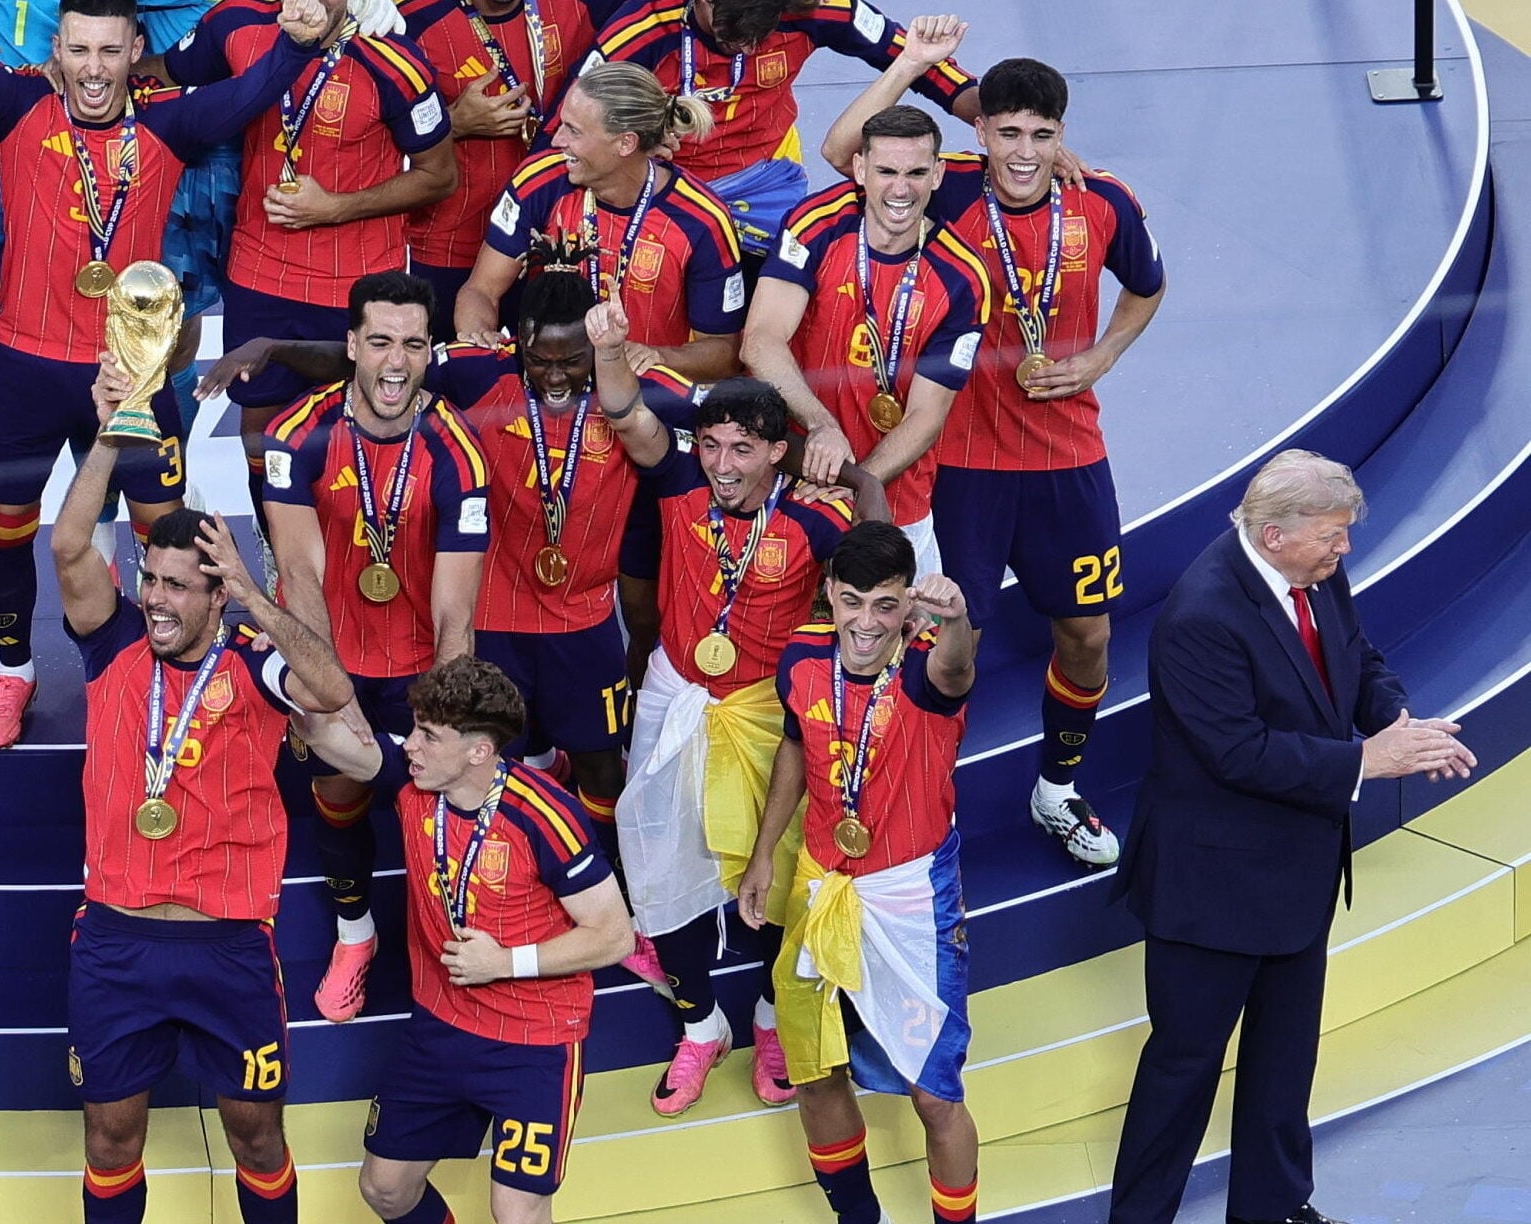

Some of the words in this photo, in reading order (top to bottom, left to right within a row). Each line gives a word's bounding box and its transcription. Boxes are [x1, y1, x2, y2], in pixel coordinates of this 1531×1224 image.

[294, 109, 307, 132] WORLD
[303, 95, 312, 110] CUP
[309, 72, 326, 97] 2026
[105, 222, 115, 237] CUP
[110, 198, 123, 222] 2026
[626, 226, 636, 241] FIFA
[633, 202, 646, 227] WORLD
[643, 182, 652, 198] CUP
[989, 203, 999, 219] FIFA
[993, 218, 1007, 248] WORLD
[1052, 212, 1060, 241] 2026
[1001, 248, 1012, 265] CUP
[1006, 264, 1020, 292] 2026
[1048, 257, 1057, 284] WORLD
[897, 292, 909, 319] 2026
[1042, 284, 1051, 303] FIFA
[894, 319, 903, 335] CUP
[889, 336, 900, 361] WORLD
[887, 361, 896, 377] FIFA
[529, 398, 538, 415] FIFA
[575, 400, 588, 426] 2026
[532, 415, 543, 442] WORLD
[571, 427, 581, 442] CUP
[158, 436, 182, 487] 3
[357, 450, 367, 476] WORLD
[401, 452, 409, 468] CUP
[537, 443, 545, 460] CUP
[567, 443, 578, 471] WORLD
[361, 476, 369, 491] CUP
[394, 467, 406, 495] WORLD
[539, 459, 549, 485] 2026
[563, 471, 572, 488] FIFA
[363, 490, 374, 516] 2026
[391, 495, 401, 511] FIFA
[1073, 545, 1124, 605] 22
[207, 653, 218, 669] FIFA
[192, 668, 212, 696] WORLD
[151, 700, 160, 730] WORLD
[186, 695, 196, 712] CUP
[601, 677, 630, 735] 17
[834, 699, 842, 727] 2026
[864, 705, 874, 721] FIFA
[175, 711, 190, 739] 2026
[859, 721, 870, 749] WORLD
[149, 730, 158, 747] FIFA
[856, 749, 866, 766] CUP
[852, 766, 863, 792] 2026
[436, 810, 445, 827] CUP
[437, 827, 445, 856] 2026
[466, 840, 479, 867] 2026
[242, 1041, 282, 1091] 16
[495, 1118, 554, 1177] 25
